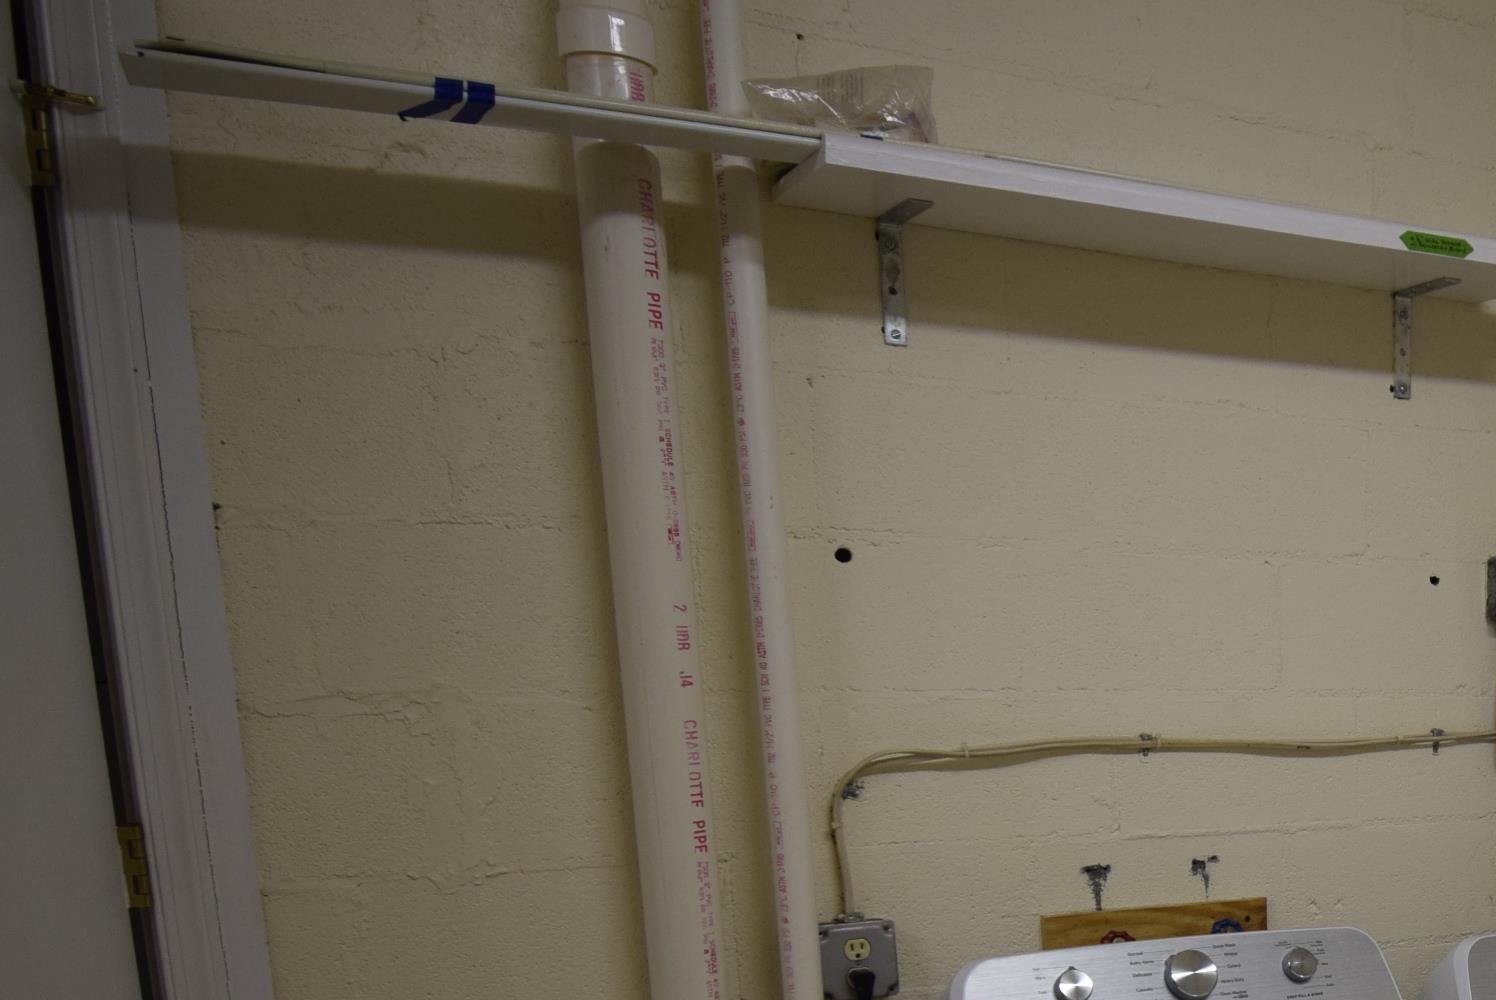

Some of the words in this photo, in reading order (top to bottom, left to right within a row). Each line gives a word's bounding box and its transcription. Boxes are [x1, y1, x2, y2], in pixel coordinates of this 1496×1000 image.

[637, 178, 659, 280] CHARLOTTE
[646, 291, 663, 330] PIPE
[664, 428, 674, 466] SCHEDULE
[673, 604, 688, 612] 2
[683, 719, 705, 808] CHARLOTTE
[692, 819, 708, 854] PIPE
